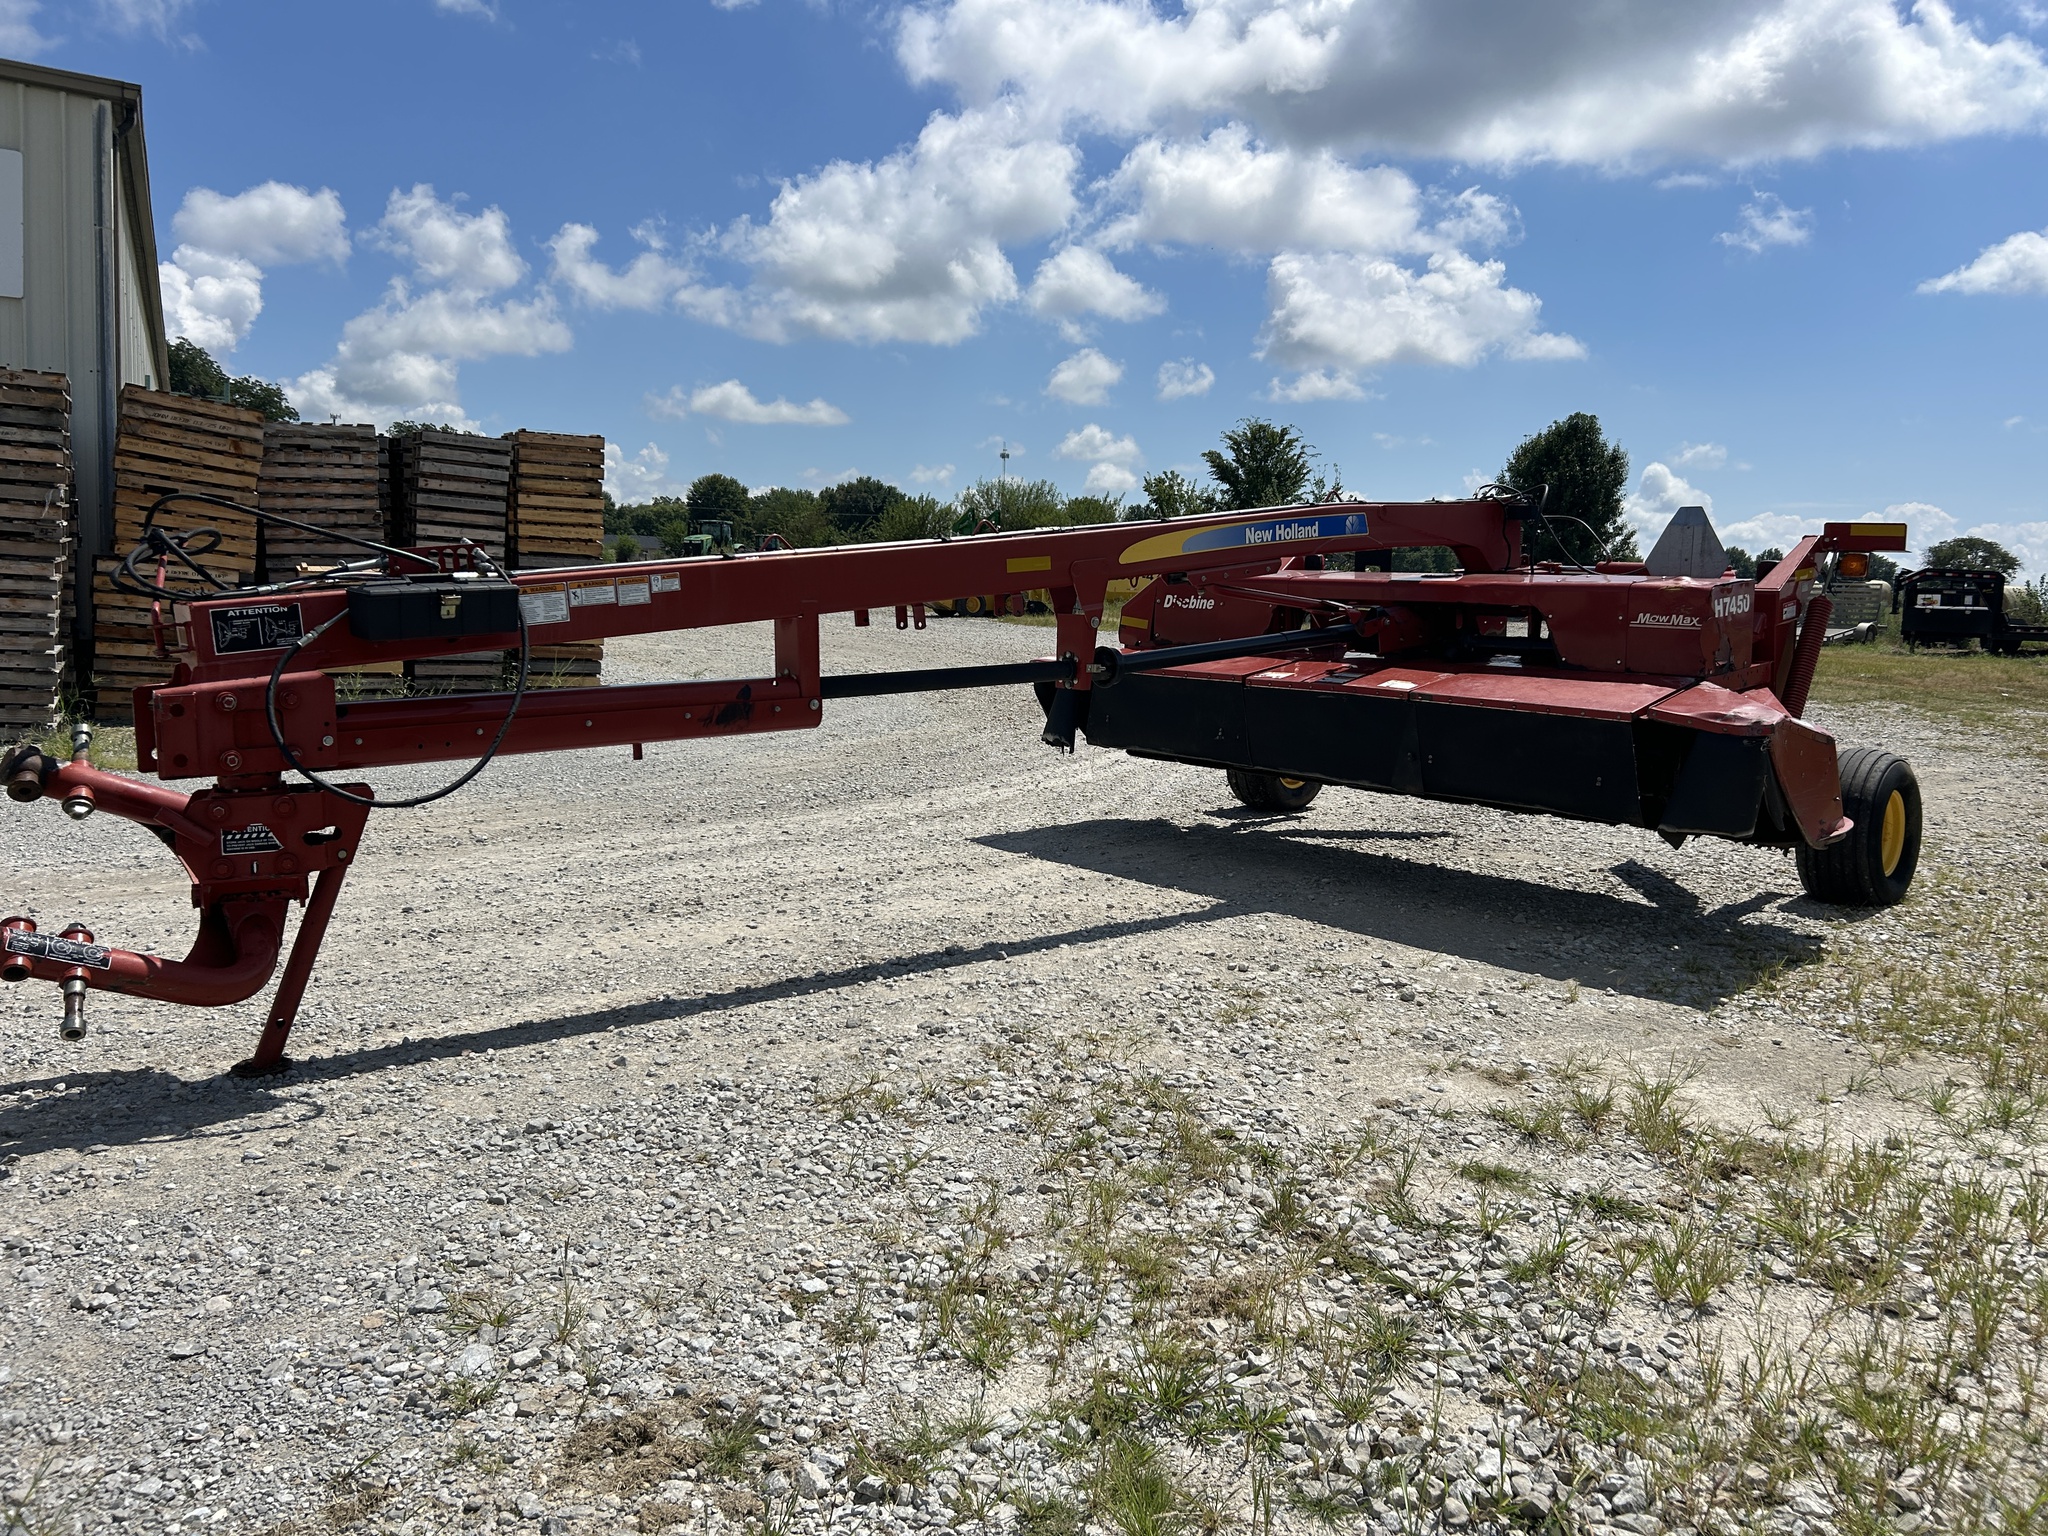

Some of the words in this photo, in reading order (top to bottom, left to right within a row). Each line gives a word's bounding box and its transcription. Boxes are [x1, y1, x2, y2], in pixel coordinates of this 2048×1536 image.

[1245, 527, 1273, 544] New
[1275, 521, 1319, 540] Holland
[583, 579, 608, 587] WARNING
[530, 585, 557, 593] WARNING
[1714, 593, 1750, 618] H7450
[227, 606, 288, 617] ATTENTION
